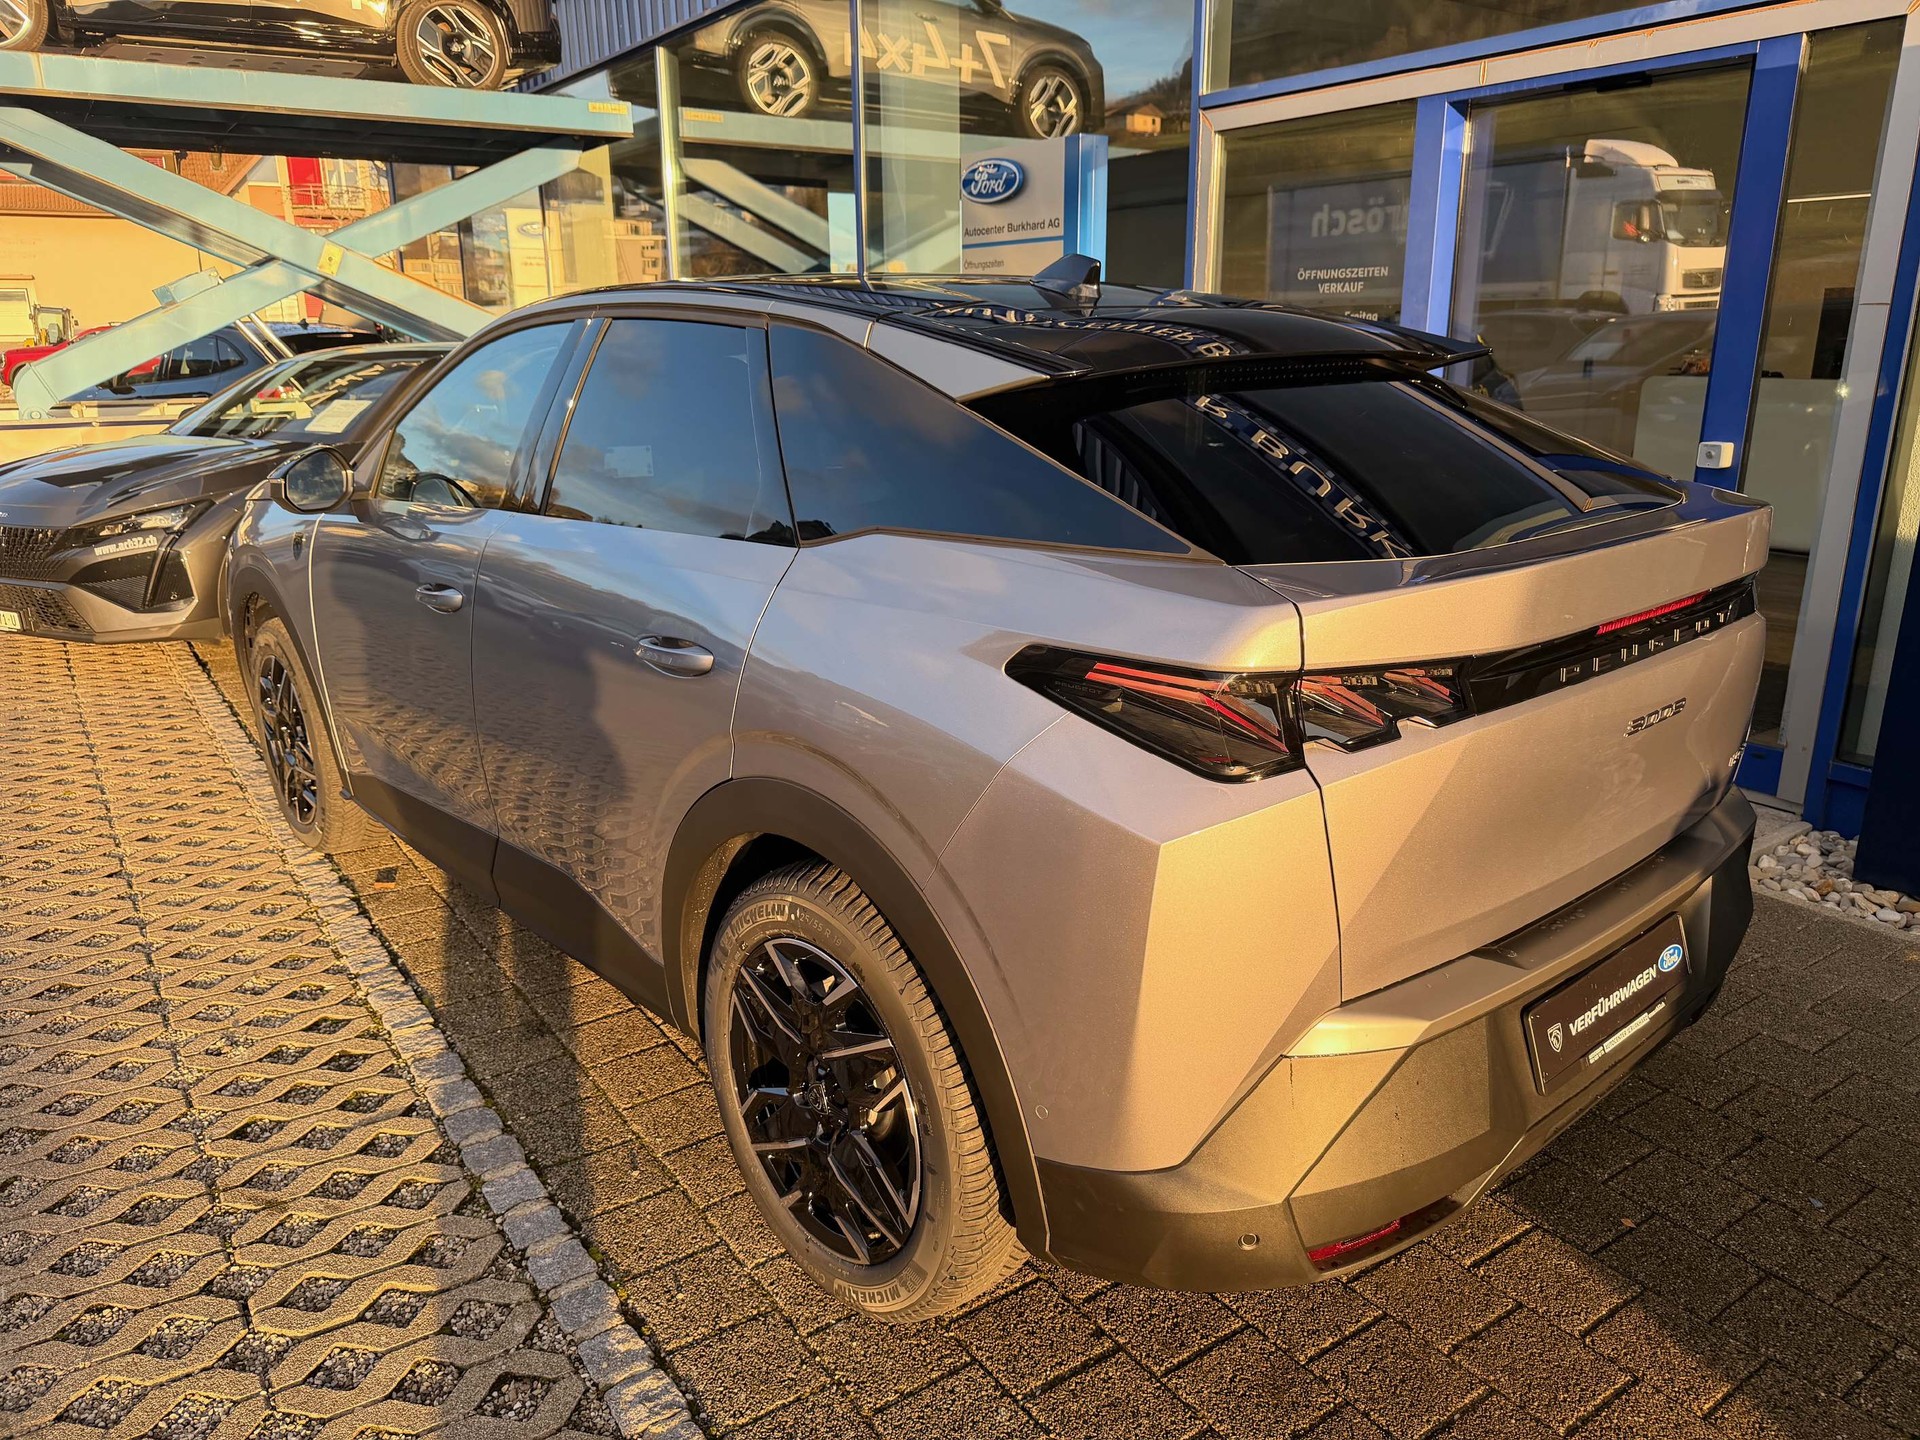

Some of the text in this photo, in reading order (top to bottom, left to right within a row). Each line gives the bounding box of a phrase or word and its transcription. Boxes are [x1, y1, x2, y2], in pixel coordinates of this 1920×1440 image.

[964, 217, 1061, 238] Autocenter Burkhard AG
[963, 258, 1005, 271] Öffnungszeiten
[1297, 265, 1389, 281] ÖFFNUNGSZEITEN
[1318, 281, 1364, 294] VERKAUF
[730, 902, 787, 938] MICHELIN
[1569, 963, 1657, 1036] VERFÜHRWAGEN
[836, 1281, 901, 1304] MICHELIN
